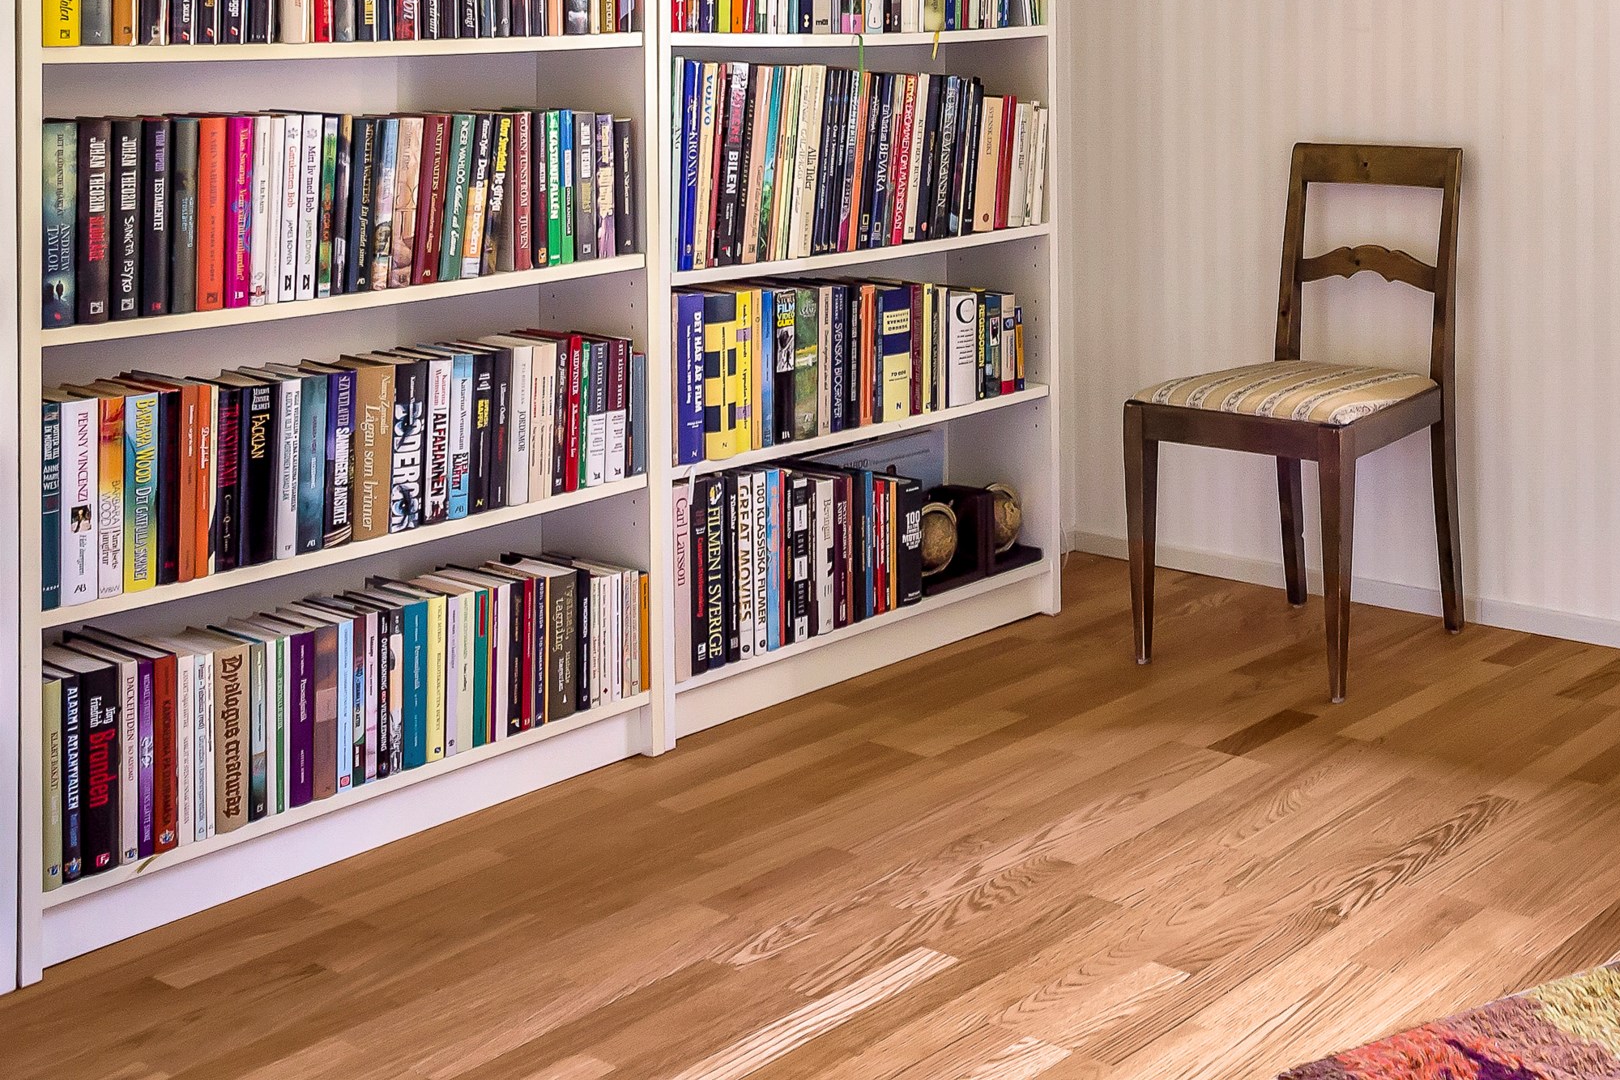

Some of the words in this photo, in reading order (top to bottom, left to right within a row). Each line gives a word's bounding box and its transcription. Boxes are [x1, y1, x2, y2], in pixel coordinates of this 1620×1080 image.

[704, 74, 713, 126] VOLVO
[89, 137, 106, 168] JOHAN
[121, 136, 137, 167] JOHAN
[459, 120, 469, 146] INGER
[307, 145, 317, 163] Mitt
[476, 158, 487, 179] Den
[687, 131, 698, 187] KRONAN
[726, 150, 739, 194] BILEN
[807, 145, 816, 165] Alla
[876, 142, 889, 192] BEVARA
[89, 172, 105, 212] THEORIN
[120, 170, 137, 210] THEORIN
[305, 177, 315, 195] med
[474, 180, 486, 211] andre
[495, 172, 505, 184] De
[153, 177, 165, 231] TESTAMENTET
[287, 192, 296, 208] Bob
[305, 196, 314, 213] Bob
[47, 225, 60, 272] TAYLOR
[60, 223, 70, 271] ANDREW
[123, 215, 135, 256] SANKTA
[286, 219, 294, 238] JAMES
[470, 213, 482, 255] brodern
[519, 214, 528, 249] TJUVEN
[285, 240, 293, 266] BOWEN
[120, 260, 135, 293] PSYKO
[694, 311, 703, 333] DET
[834, 322, 843, 366] SVENSKA
[694, 384, 703, 413] FILM
[77, 412, 88, 448] PENNY
[135, 398, 156, 448] BARBARA
[250, 413, 270, 459] FACKLAN
[360, 404, 380, 447] Lågan
[458, 411, 467, 450] Wennstam
[135, 448, 155, 483] WOOD
[363, 450, 374, 477] som
[430, 412, 447, 498] ALFAHANNEN
[77, 450, 88, 503] VINCENZI
[135, 487, 153, 505] DET
[756, 482, 765, 504] 100
[101, 492, 112, 527] WOOD
[111, 480, 121, 524] BARBARA
[362, 480, 378, 530] brinner
[675, 497, 688, 527] Carl
[739, 485, 751, 542] GREAT
[707, 505, 722, 571] FILMEN
[757, 507, 766, 575] KLASSISKA
[676, 532, 688, 587] Larsson
[738, 549, 752, 622] MOVIES
[757, 578, 766, 625] FILMER
[552, 596, 565, 652] tagning
[708, 583, 722, 659] SVERIGE
[67, 687, 78, 725] ALARM
[90, 696, 102, 728] Friedrich
[125, 676, 136, 741] DACKEFEJDEN
[67, 734, 78, 810] ATLANTVALLEN
[89, 728, 117, 807] Branden
